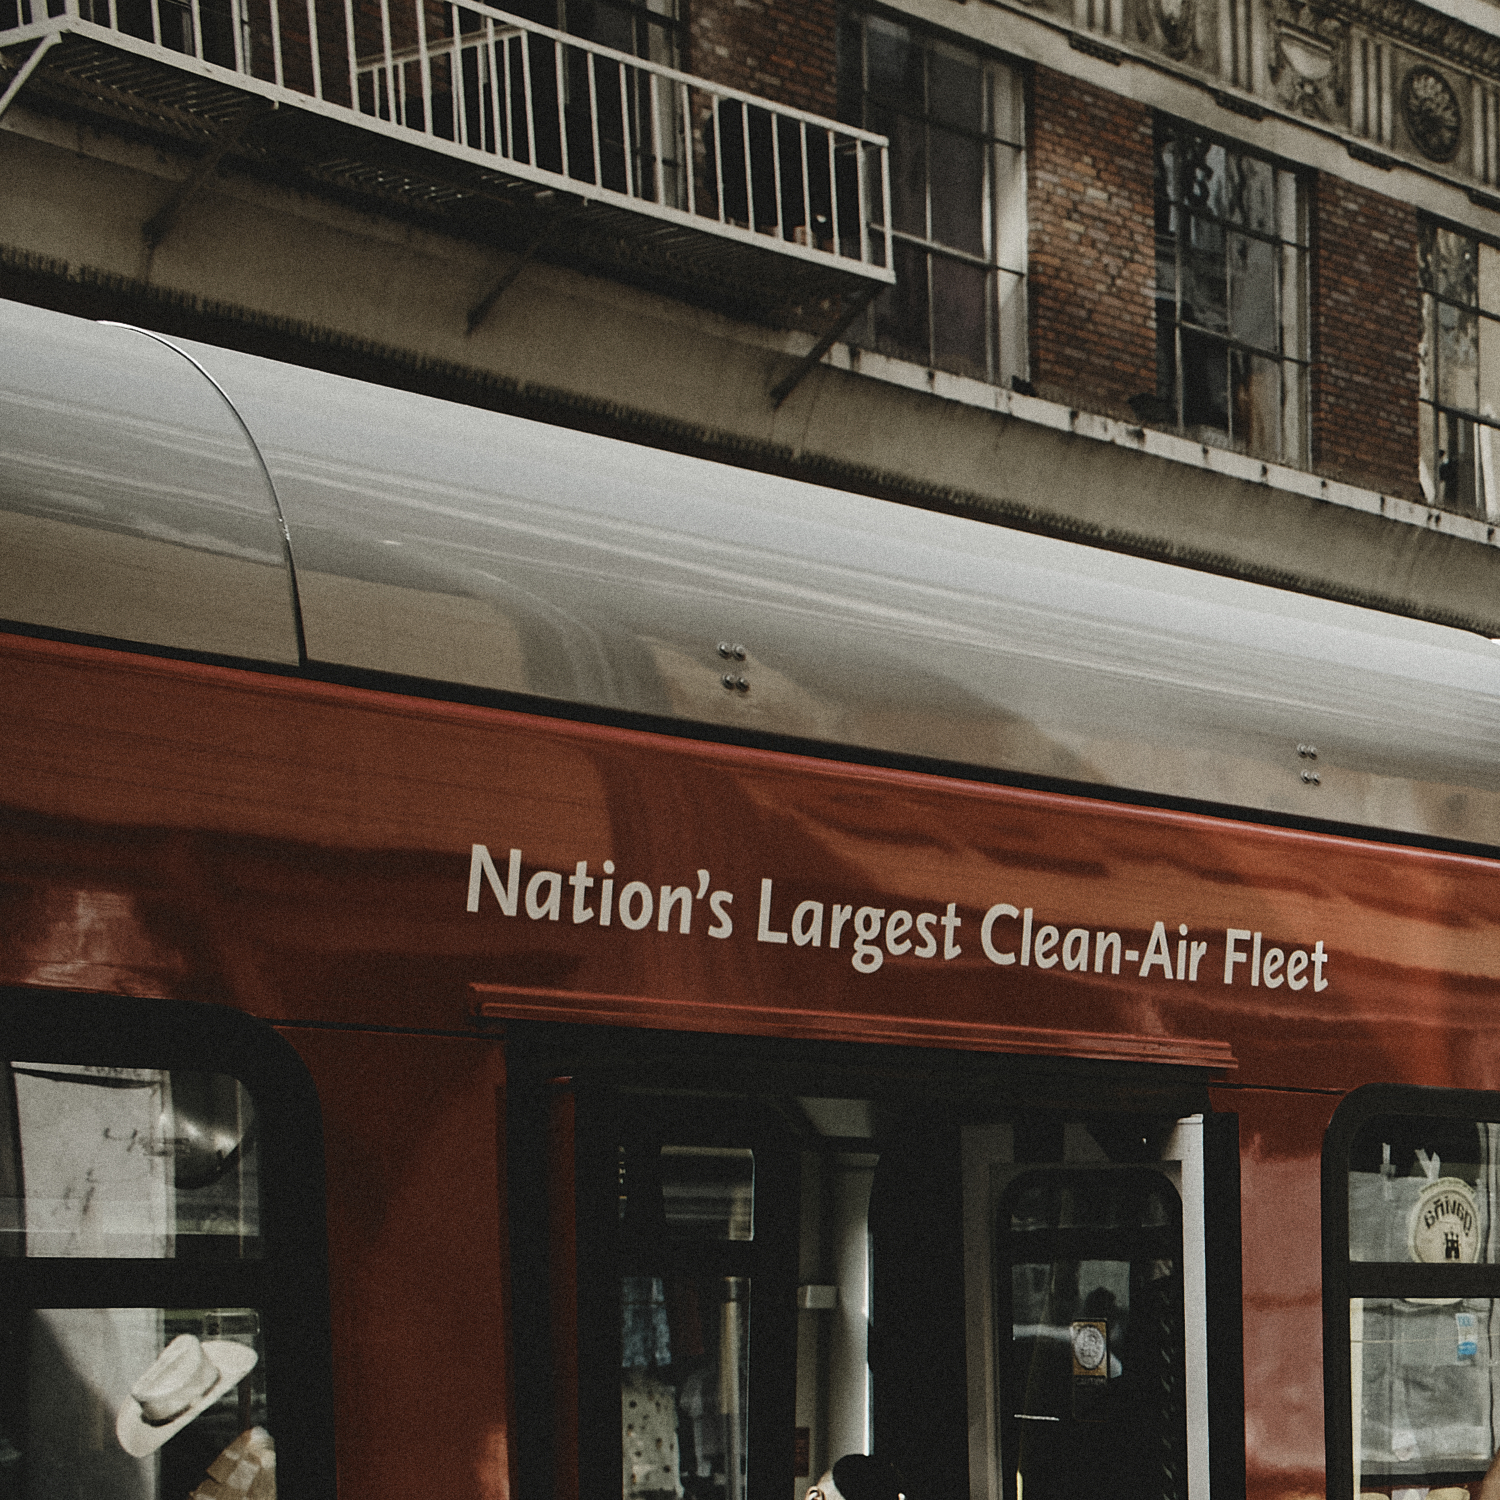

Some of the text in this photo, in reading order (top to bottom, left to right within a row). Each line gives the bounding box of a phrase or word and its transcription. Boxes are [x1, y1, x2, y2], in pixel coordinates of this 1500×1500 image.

[467, 843, 1329, 993] Nation's Largest Clean-Air Fleet
